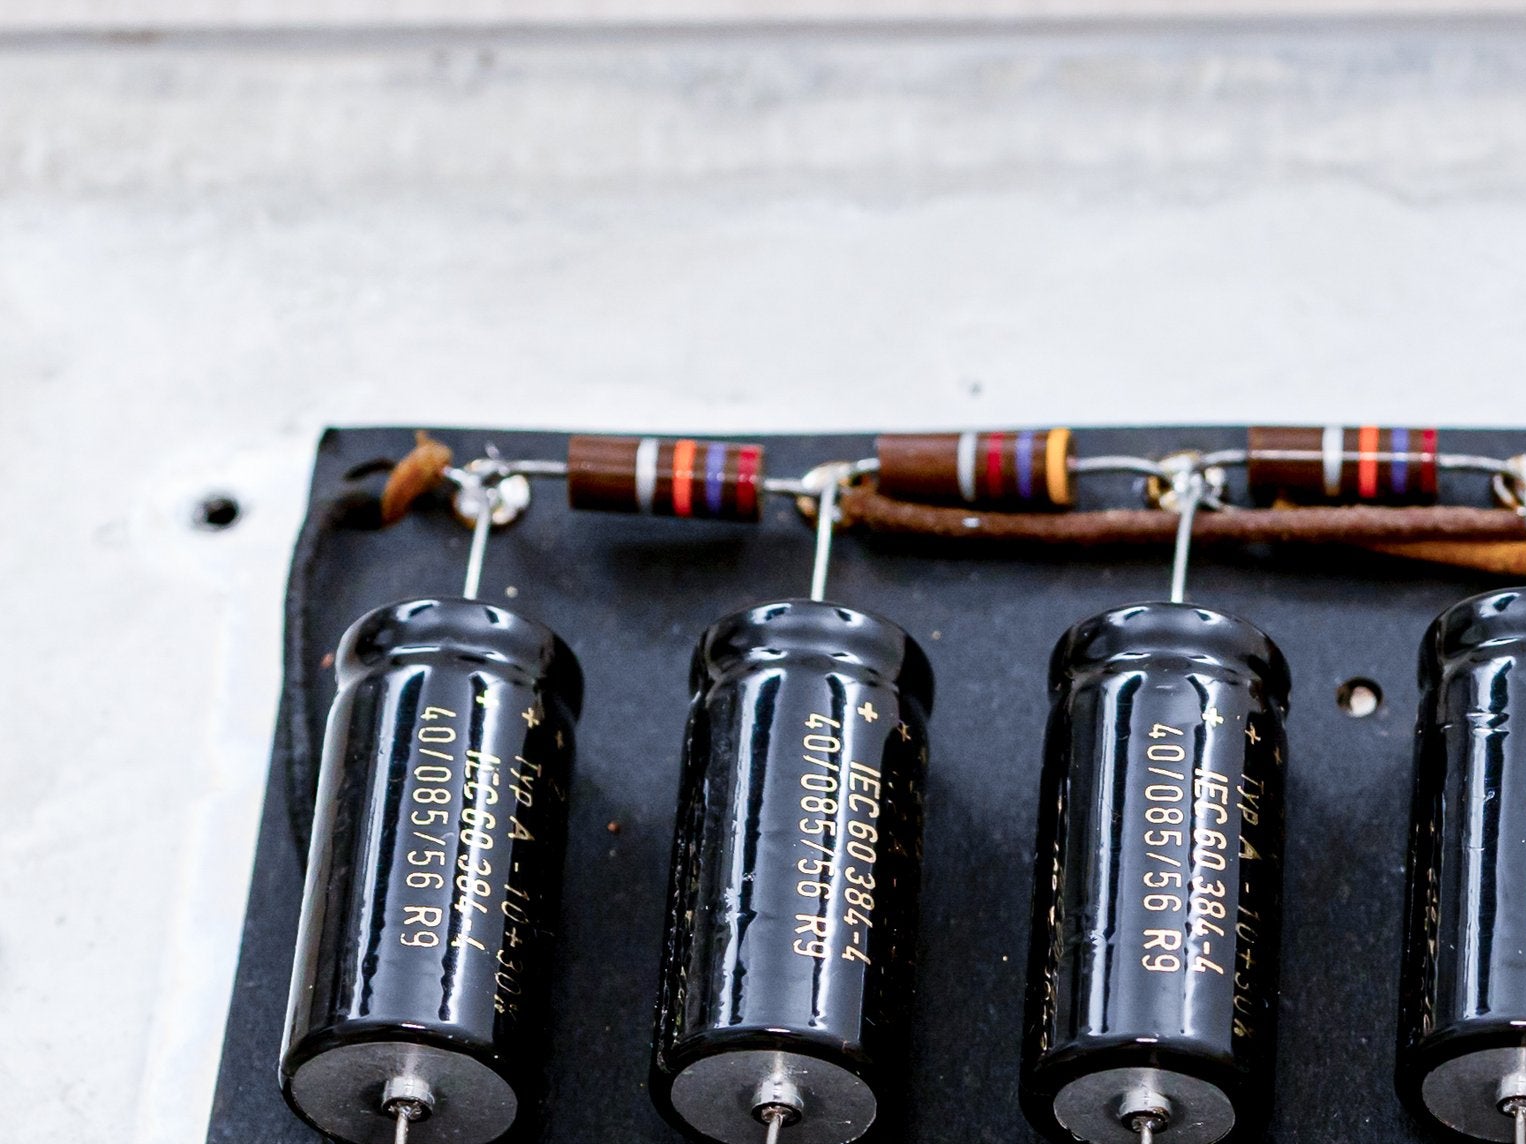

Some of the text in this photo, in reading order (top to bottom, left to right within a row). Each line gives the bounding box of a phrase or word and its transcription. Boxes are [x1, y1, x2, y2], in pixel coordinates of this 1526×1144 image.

[400, 706, 458, 949] 40/085/56 R9
[793, 713, 840, 958] 40/085/56 R9
[1143, 723, 1185, 973] 40/085/56 R9
